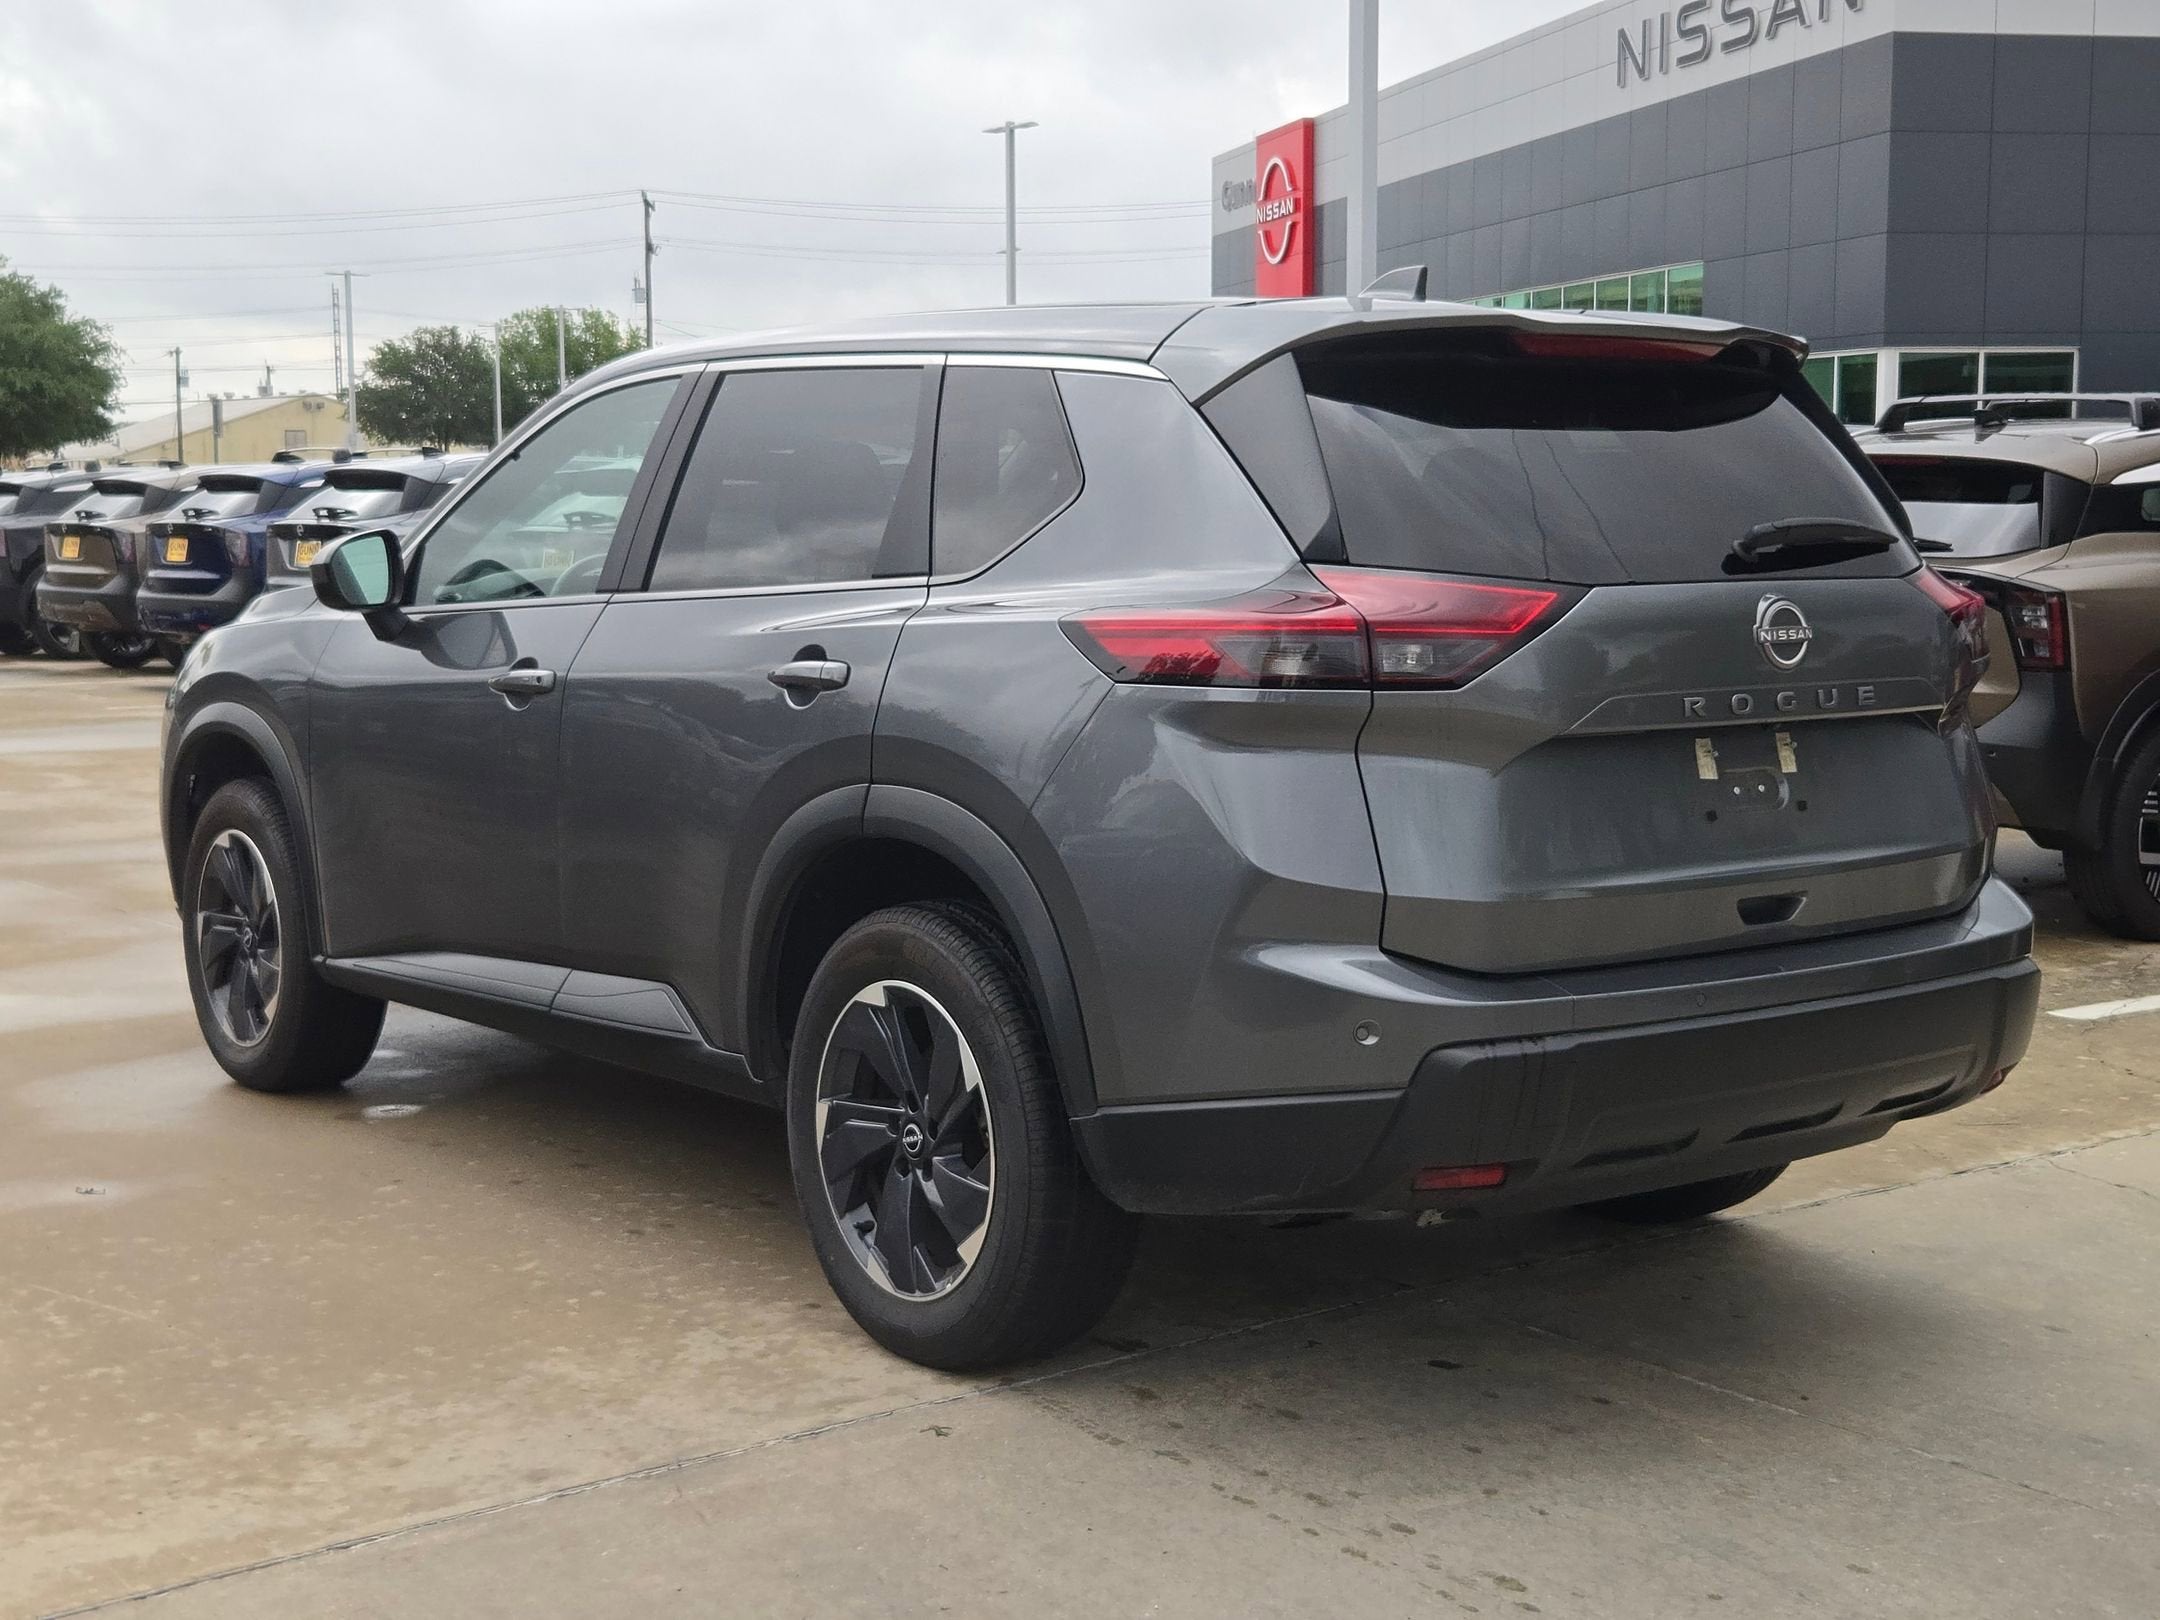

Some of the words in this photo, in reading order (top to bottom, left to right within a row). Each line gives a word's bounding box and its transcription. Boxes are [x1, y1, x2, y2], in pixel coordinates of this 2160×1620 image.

[1256, 197, 1294, 225] NISSAN
[1760, 629, 1813, 641] NISSAN
[1683, 685, 1877, 718] ROGUE
